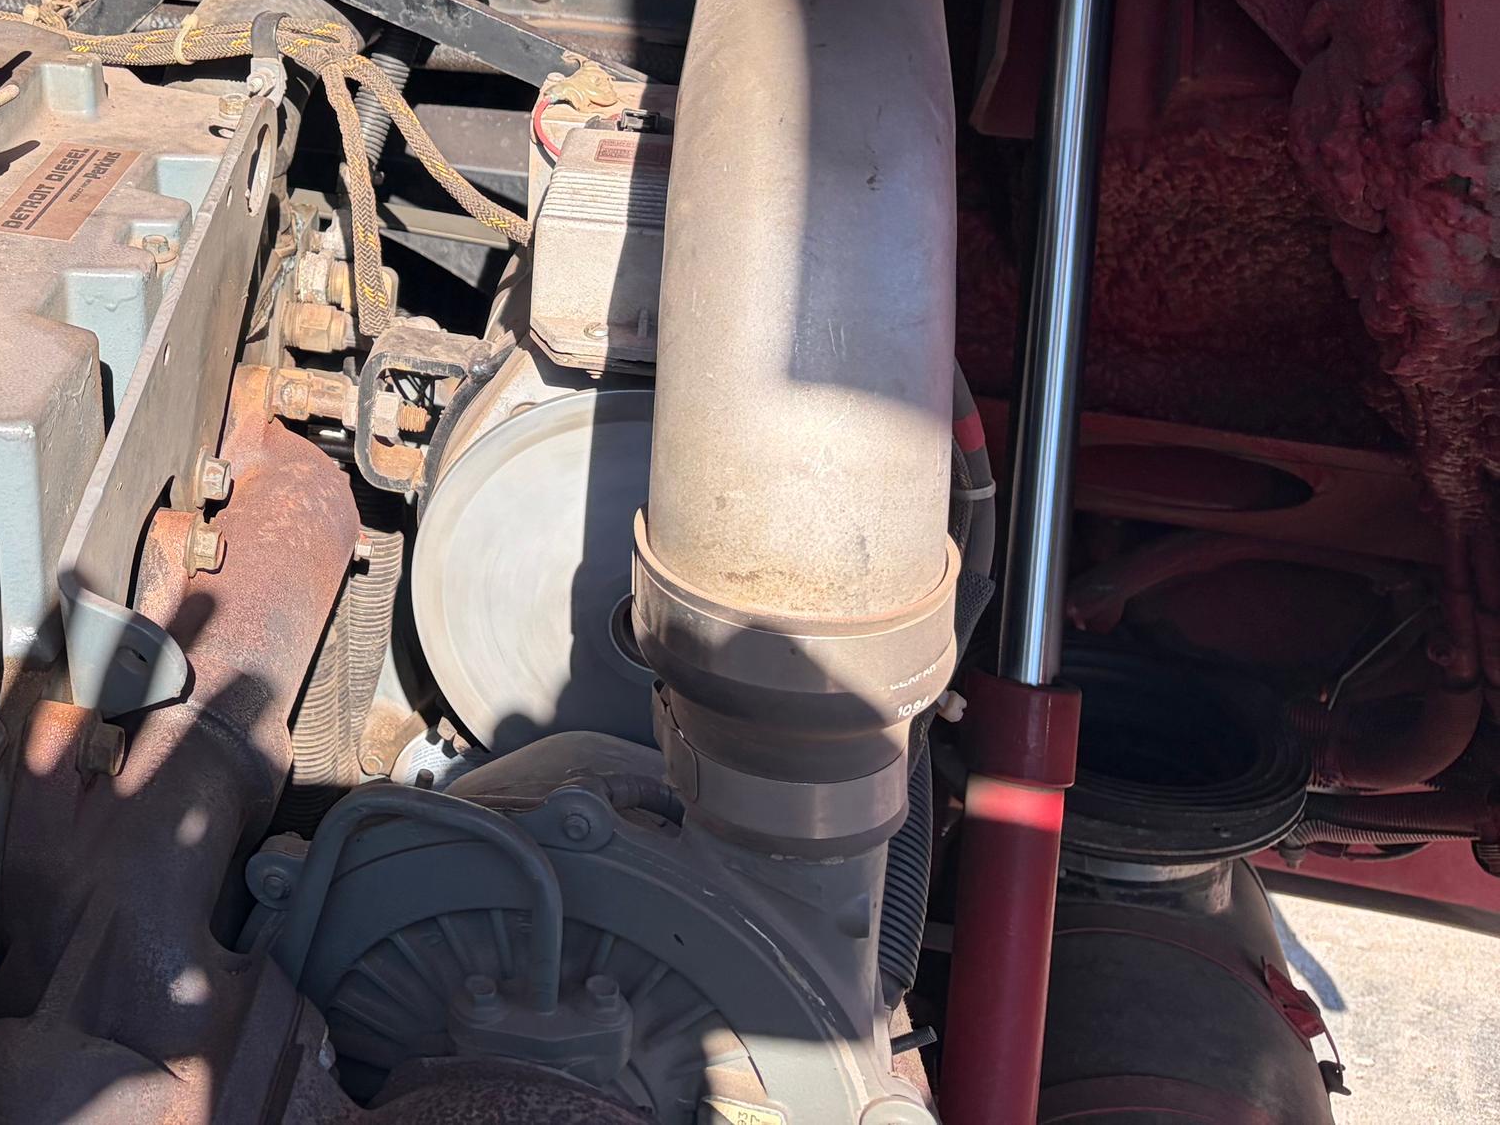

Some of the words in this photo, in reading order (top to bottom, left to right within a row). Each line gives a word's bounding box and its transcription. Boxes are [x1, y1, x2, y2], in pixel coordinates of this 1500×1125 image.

[0, 182, 56, 229] DETROIT
[43, 146, 90, 182] DIESEL
[81, 150, 123, 180] Perkins
